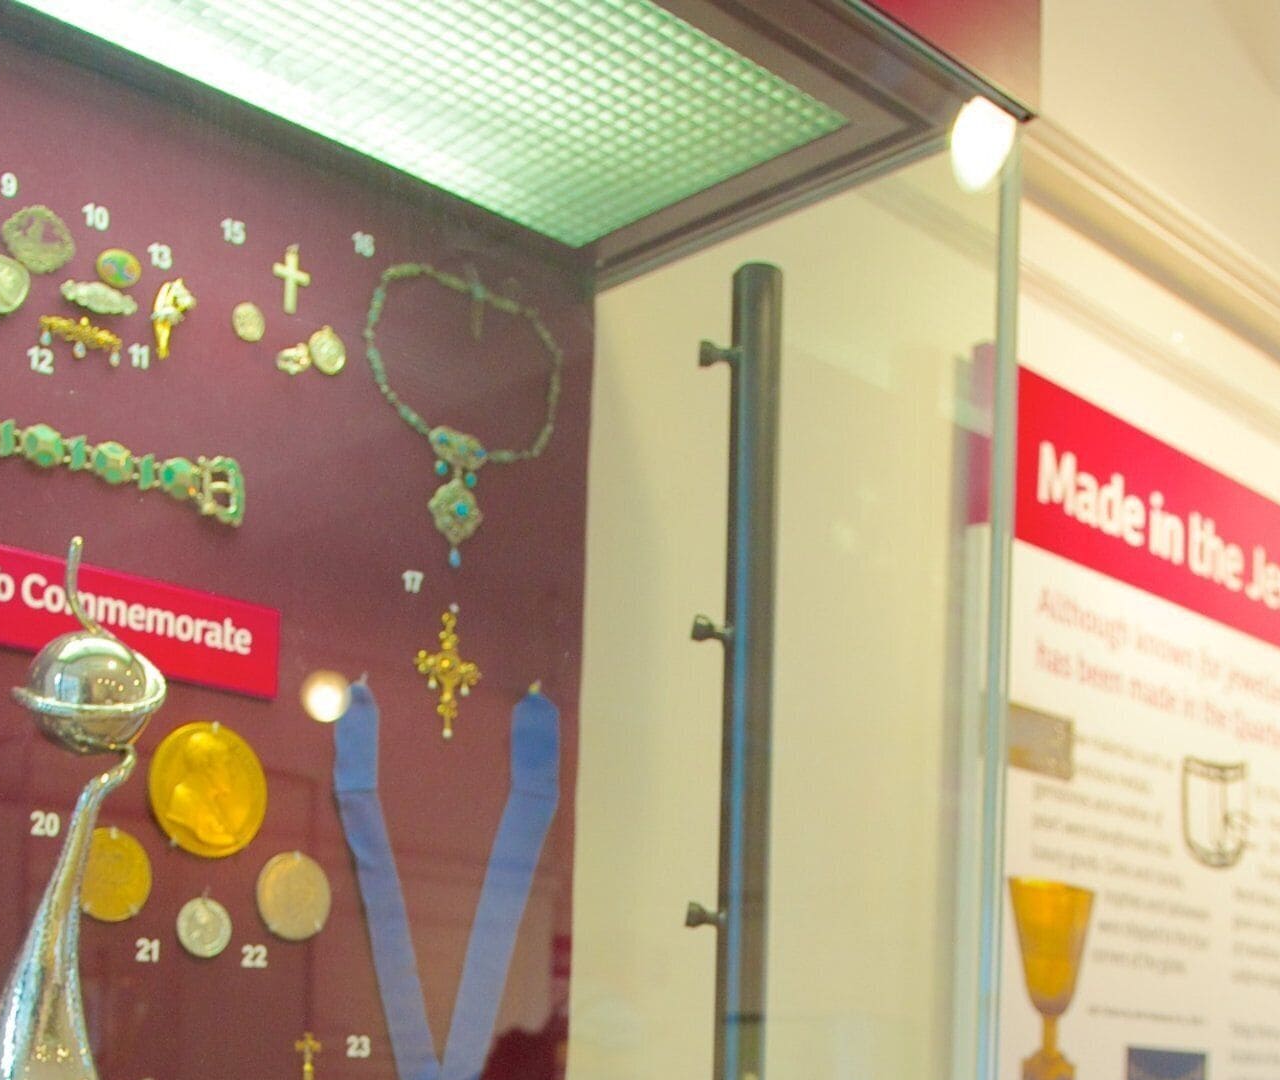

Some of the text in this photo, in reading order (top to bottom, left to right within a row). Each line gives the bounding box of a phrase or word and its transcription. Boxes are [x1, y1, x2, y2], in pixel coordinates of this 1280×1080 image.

[0, 172, 18, 198] 9
[82, 203, 110, 231] 10
[220, 218, 246, 245] 15
[147, 242, 174, 271] 13
[27, 348, 54, 375] 12
[128, 343, 150, 370] 11
[1037, 440, 1145, 547] Made
[1149, 491, 1184, 565] in
[1188, 511, 1244, 592] the
[402, 570, 424, 594] 17
[21, 572, 253, 656] Commemorate
[30, 810, 61, 838] 20
[135, 937, 161, 963] 21
[241, 944, 268, 968] 22
[346, 1034, 371, 1058] 23
